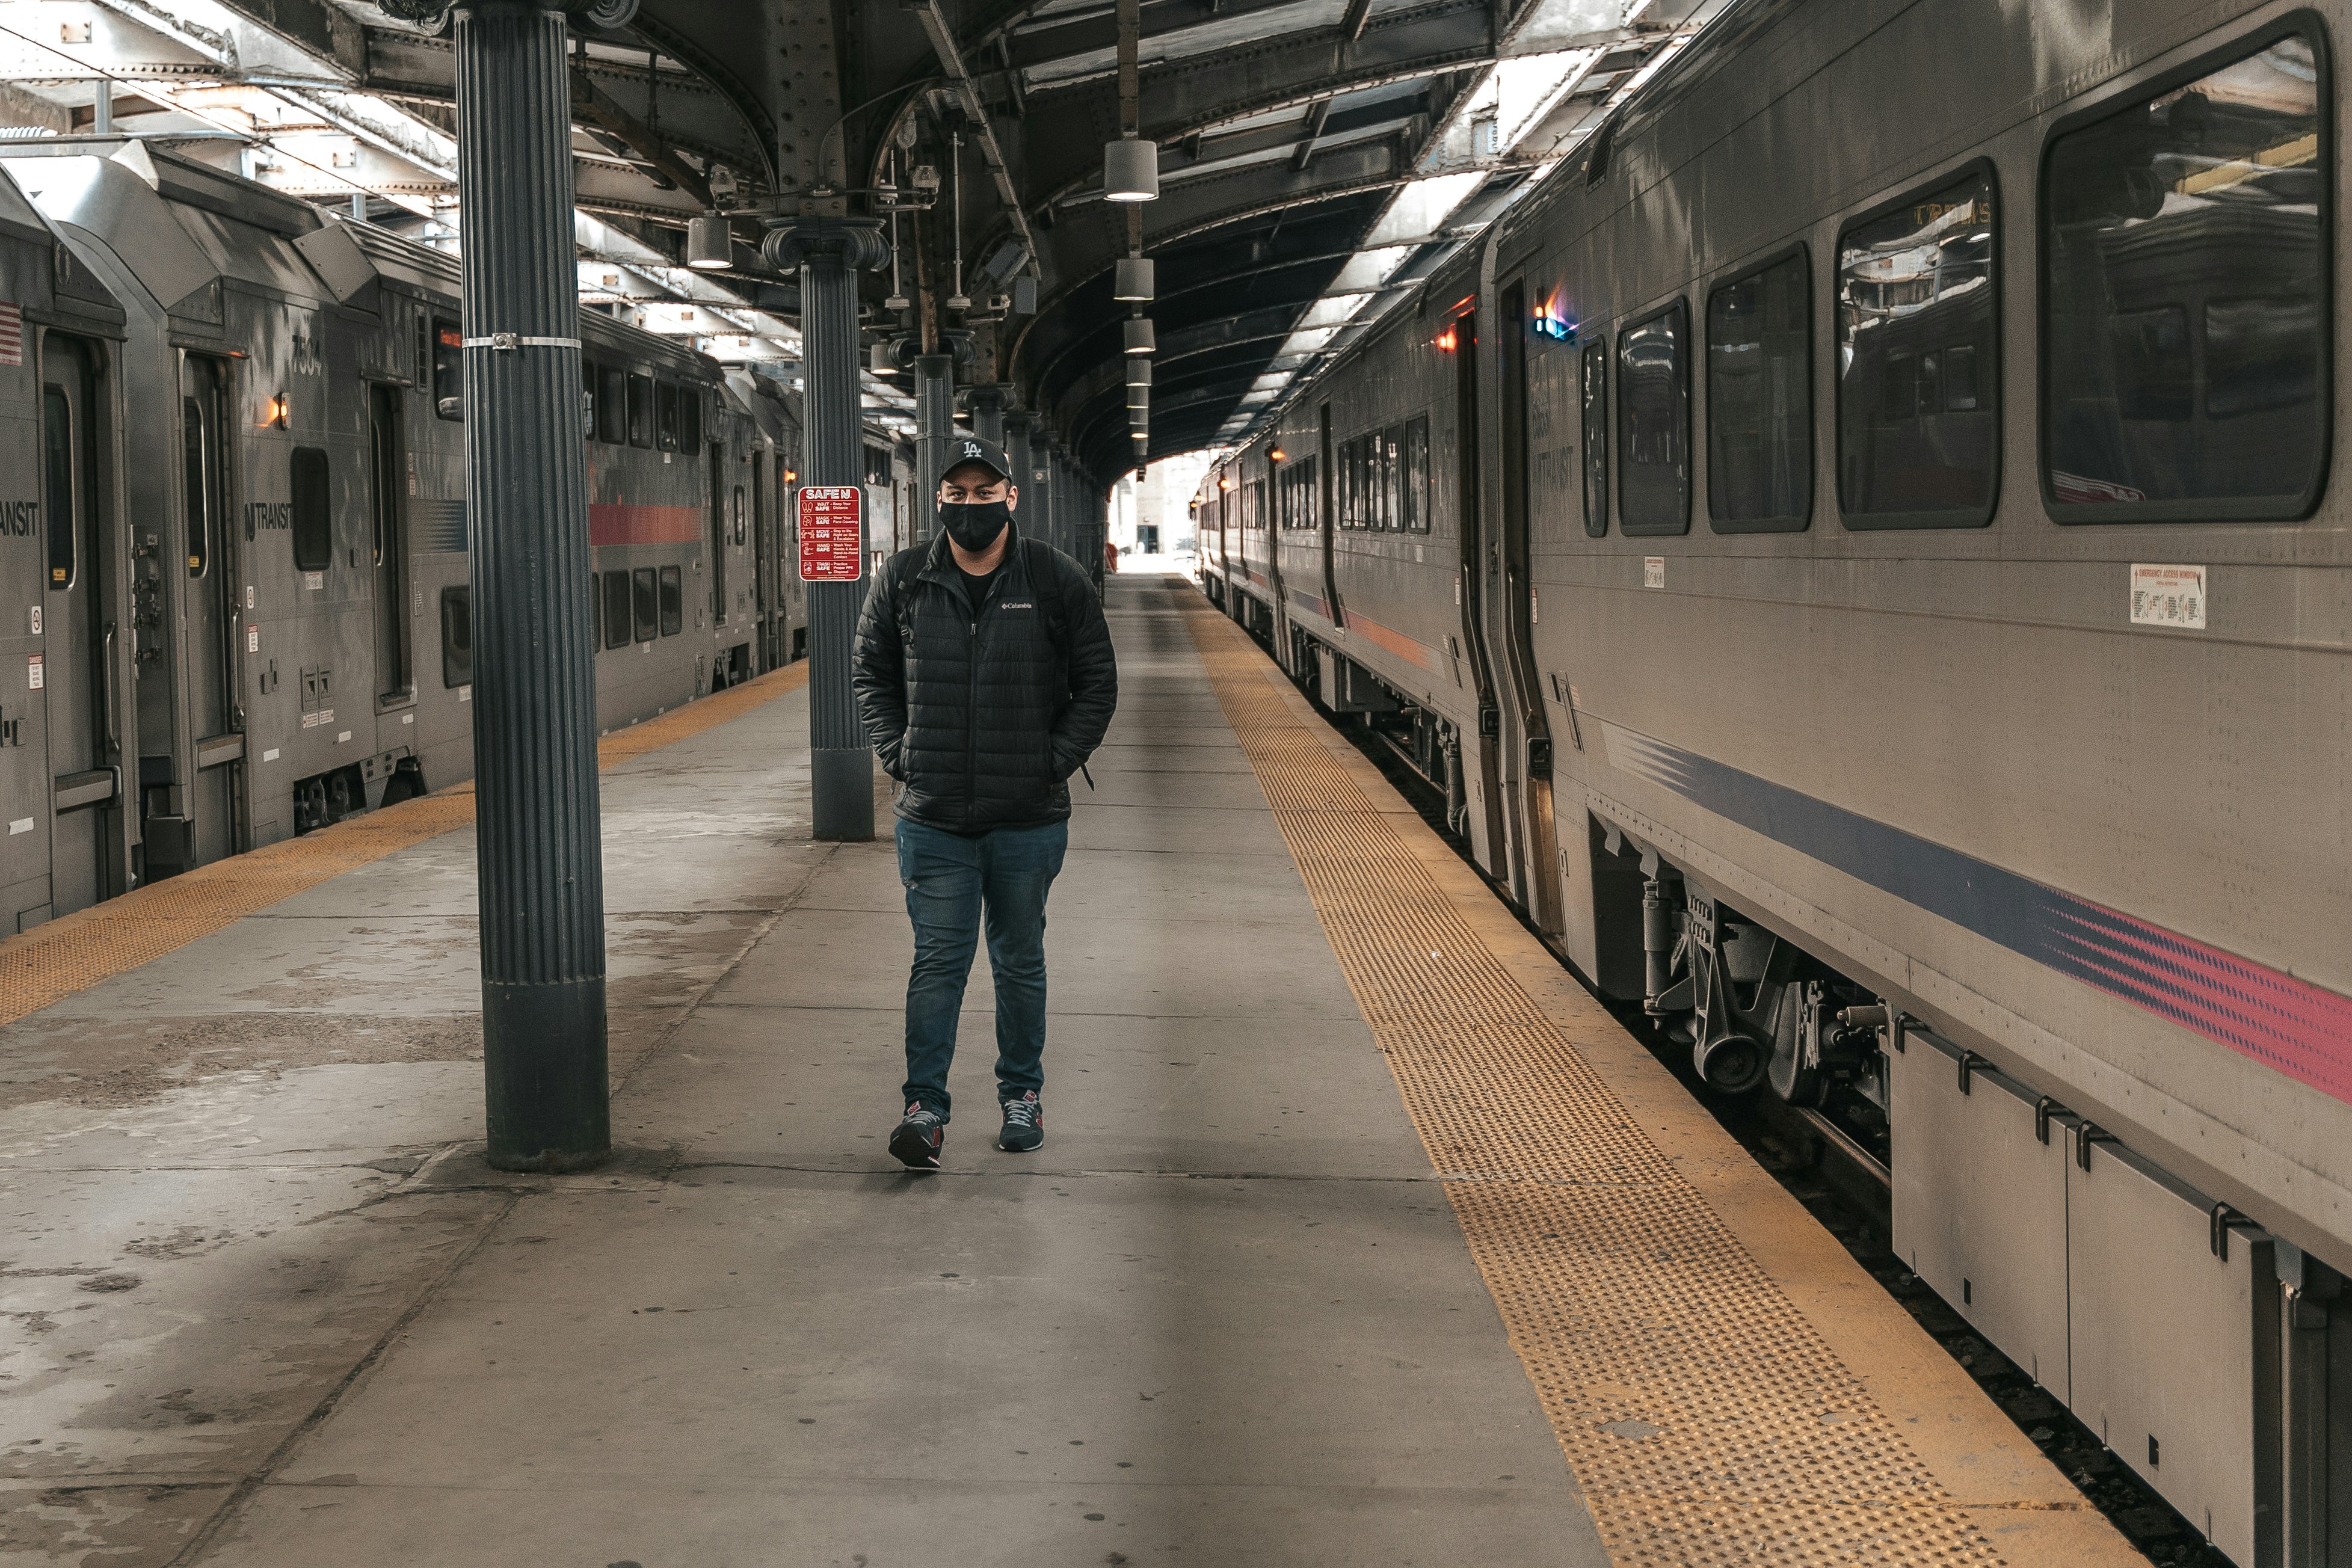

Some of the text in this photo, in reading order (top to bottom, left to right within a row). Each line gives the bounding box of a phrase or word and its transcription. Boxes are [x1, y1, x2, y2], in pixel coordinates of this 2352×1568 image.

[964, 441, 982, 458] LA
[806, 489, 839, 499] SAFE
[256, 502, 292, 529] TRANSIT
